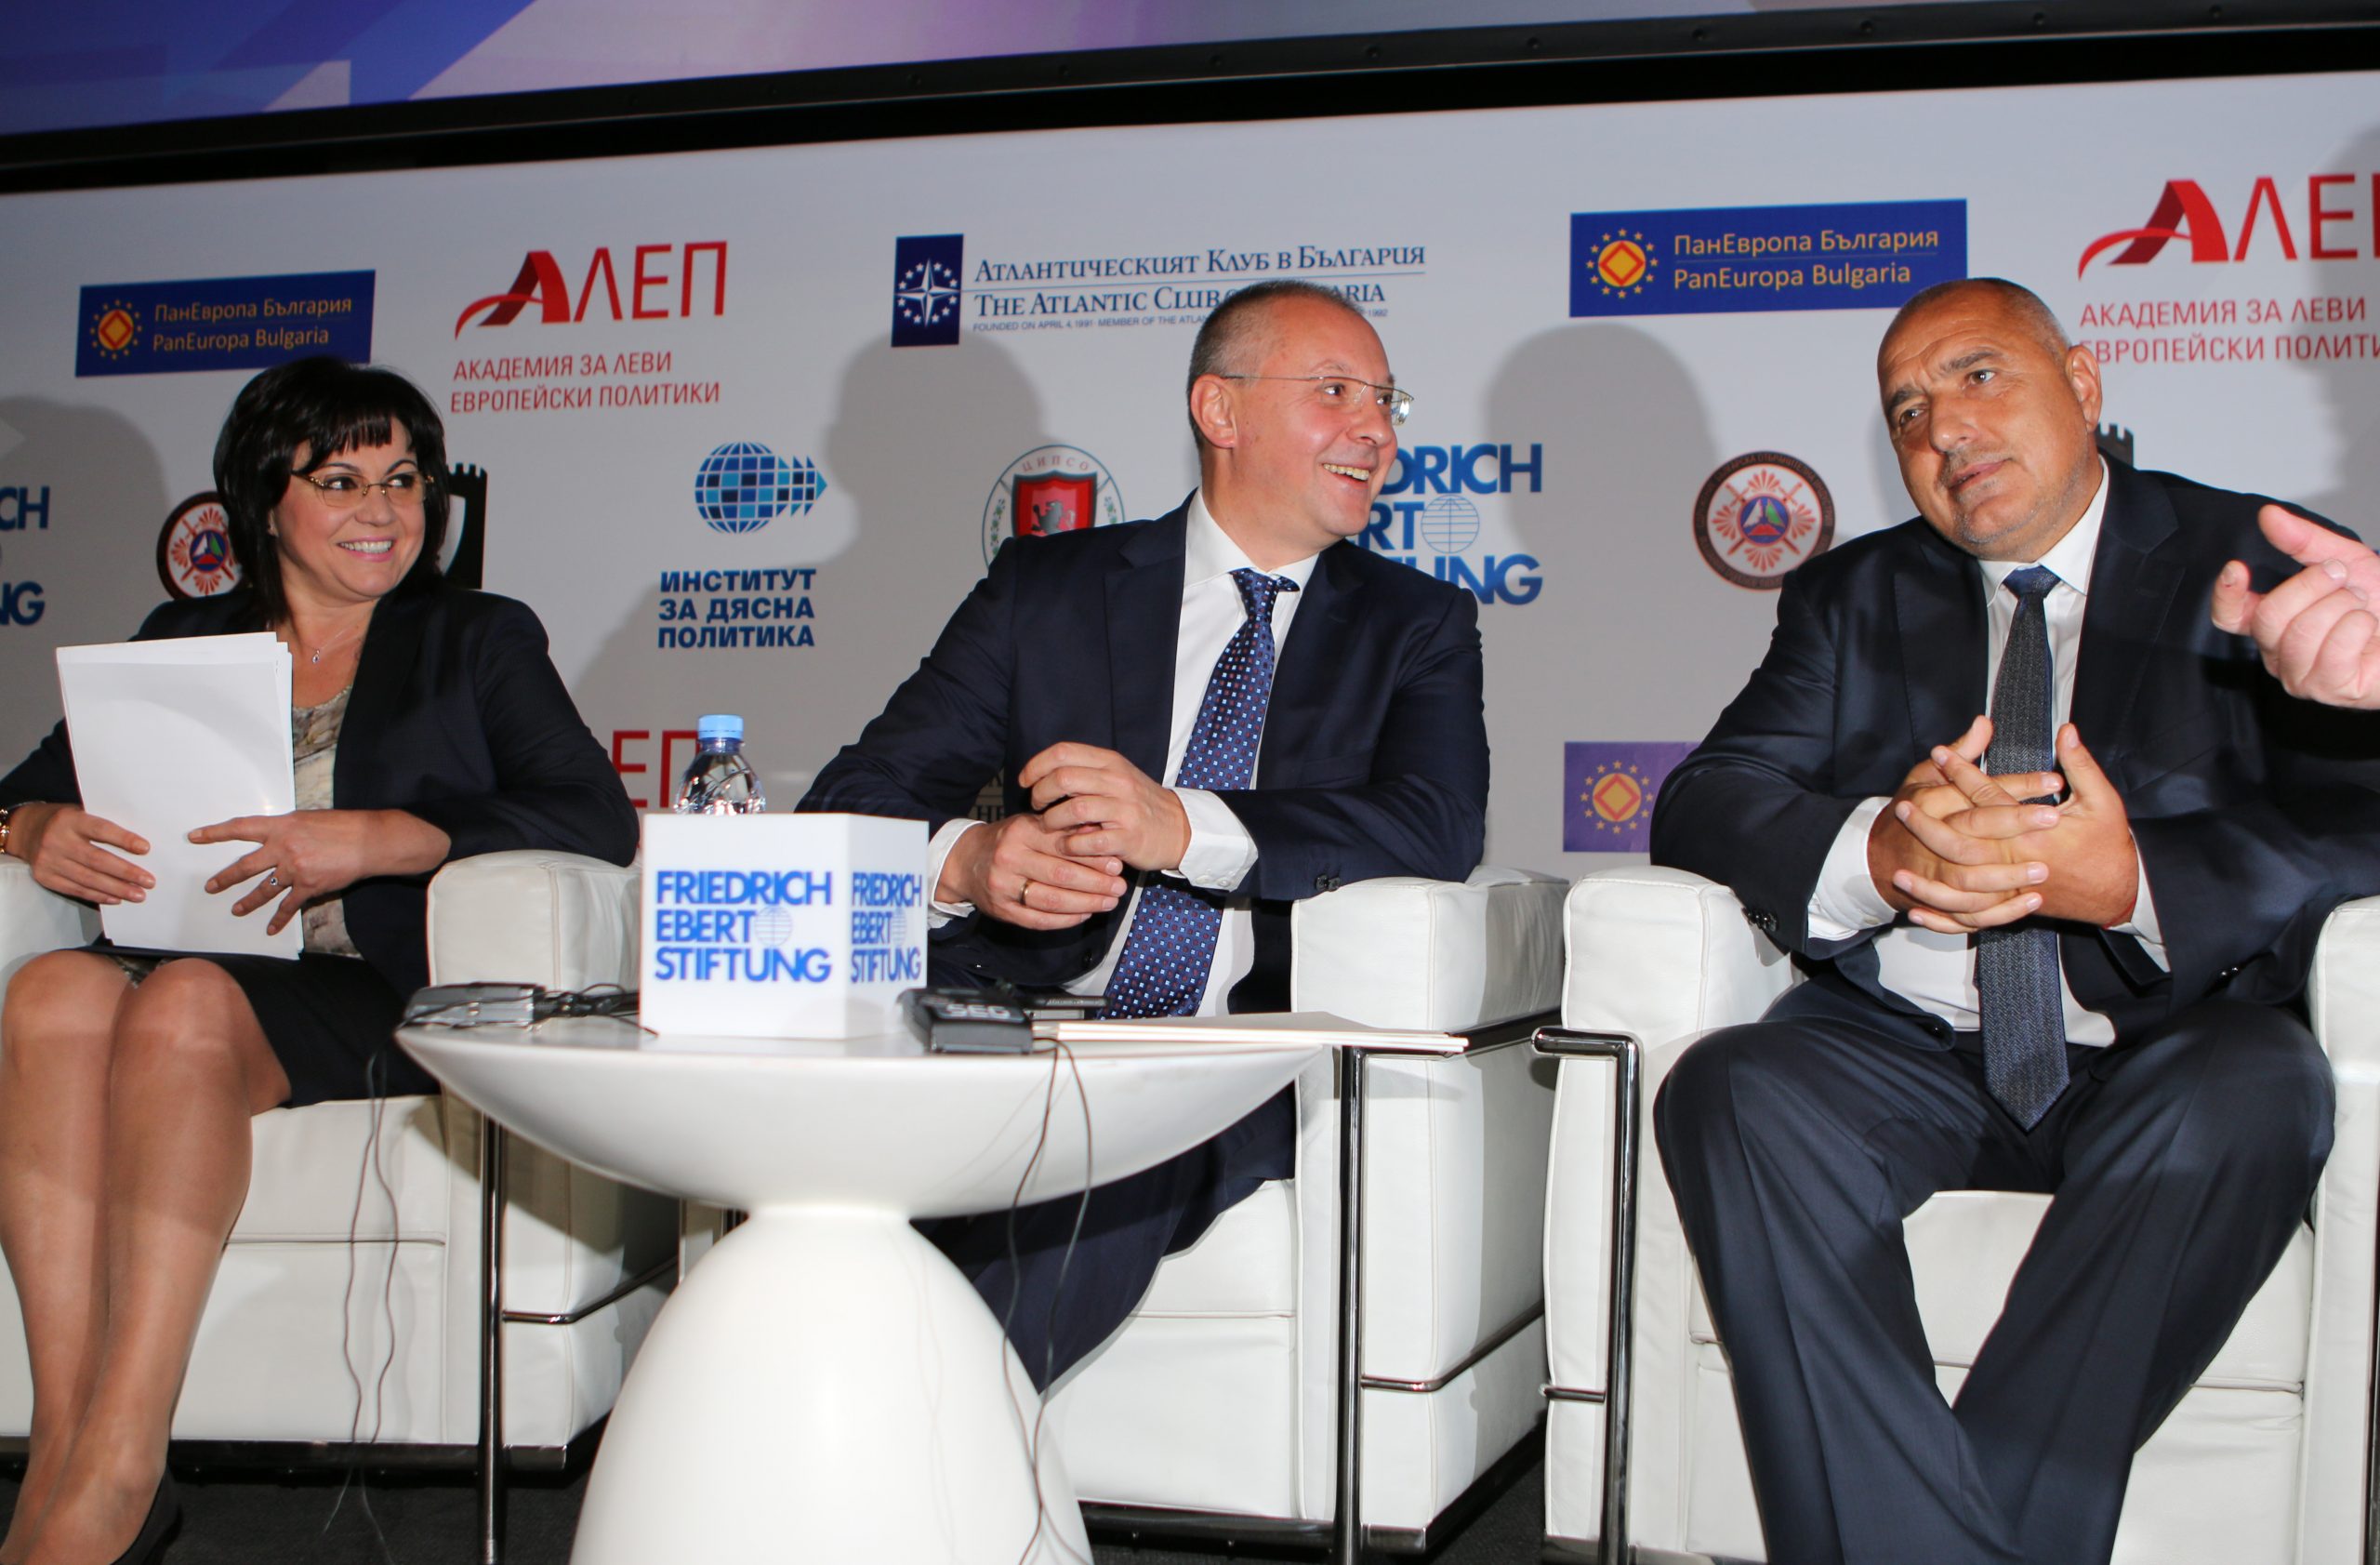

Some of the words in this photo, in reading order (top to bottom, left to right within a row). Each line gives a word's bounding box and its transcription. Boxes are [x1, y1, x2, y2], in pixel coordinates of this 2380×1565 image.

[2077, 172, 2380, 281] АЛЕ
[1674, 233, 1812, 257] ПанЕвропа
[1820, 230, 1938, 252] България
[455, 241, 727, 340] АЛЕП
[1674, 267, 1804, 290] PanEuropa
[1812, 261, 1911, 289] Bulgaria
[154, 301, 258, 323] ПанЕвропа
[263, 297, 351, 317] България
[973, 294, 1025, 317] THE
[1029, 291, 1147, 314] ATLANTIC
[2080, 299, 2237, 329] АКАДЕМИЯ
[2246, 299, 2282, 324] ЗА
[2291, 297, 2366, 323] ЛЕВИ
[1098, 316, 1139, 326] MEMBER
[152, 331, 249, 352] PanEuropa
[255, 325, 329, 350] Bulgaria
[2080, 333, 2264, 364] ВРОПЕЙСКИ
[2276, 334, 2380, 361] ПОЛИТ
[453, 354, 574, 382] АКАДЕМИЯ
[579, 353, 607, 376] ЗА
[613, 351, 672, 374] ЛЕВИ
[450, 384, 591, 414] ЕВРОПЕЙСКИ
[599, 381, 721, 408] ПОЛИТИКИ
[1379, 444, 1542, 495] DRICH
[660, 568, 816, 592] ИНСТИТУТ
[658, 598, 697, 620] ЗА
[706, 596, 815, 624] ДЯСНА
[657, 625, 815, 648] ПОЛИТИКА
[656, 870, 832, 905] FRIEDRICH
[852, 871, 922, 907] FRIEDRICH
[655, 909, 757, 943] EBERT
[852, 910, 892, 945] EBERT
[654, 947, 832, 983] STIFTUNG
[851, 947, 921, 983] STIFTUNG
